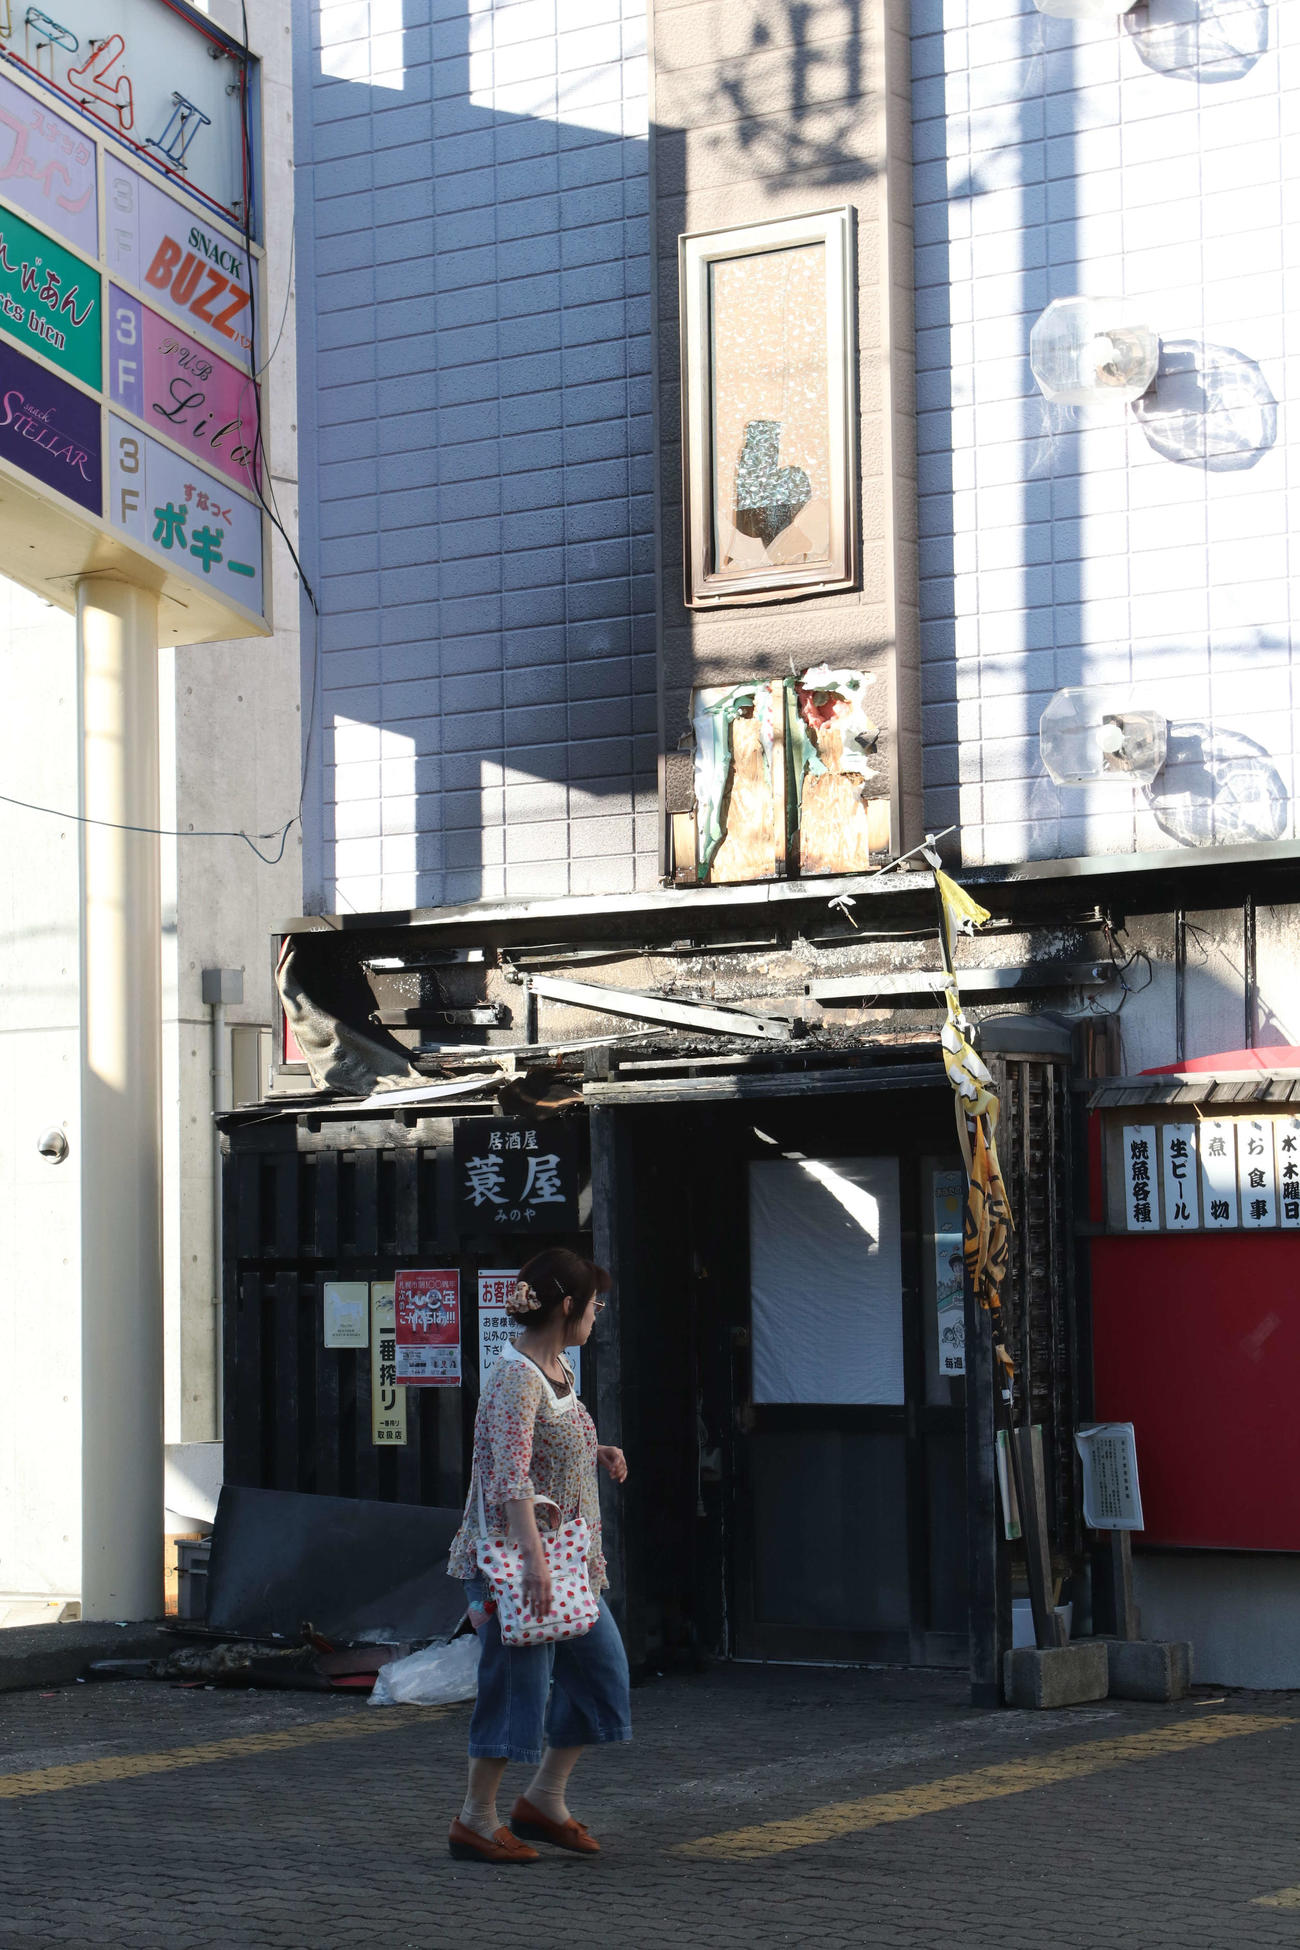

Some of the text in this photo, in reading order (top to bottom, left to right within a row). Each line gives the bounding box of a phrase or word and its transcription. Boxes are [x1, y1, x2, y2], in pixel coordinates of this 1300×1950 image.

[188, 227, 243, 280] SNACK
[144, 235, 251, 340] BUZZ
[28, 310, 65, 350] bien
[158, 338, 214, 381] PUB
[0, 390, 93, 482] STELLAR
[23, 403, 57, 423] snack
[153, 377, 251, 467] Lila
[184, 483, 232, 526] すなっく
[152, 502, 256, 578] ボギー
[489, 1130, 539, 1150] 居酒屋
[464, 1154, 567, 1207] 蓑屋
[1130, 1139, 1153, 1223] 焼魚各種
[1169, 1138, 1191, 1220] 生ビール
[1208, 1136, 1230, 1220] 煮物
[1247, 1137, 1269, 1220] お食事
[494, 1208, 536, 1223] みのや
[379, 1328, 396, 1411] 一番搾り
[377, 1430, 402, 1440] 取扱店
